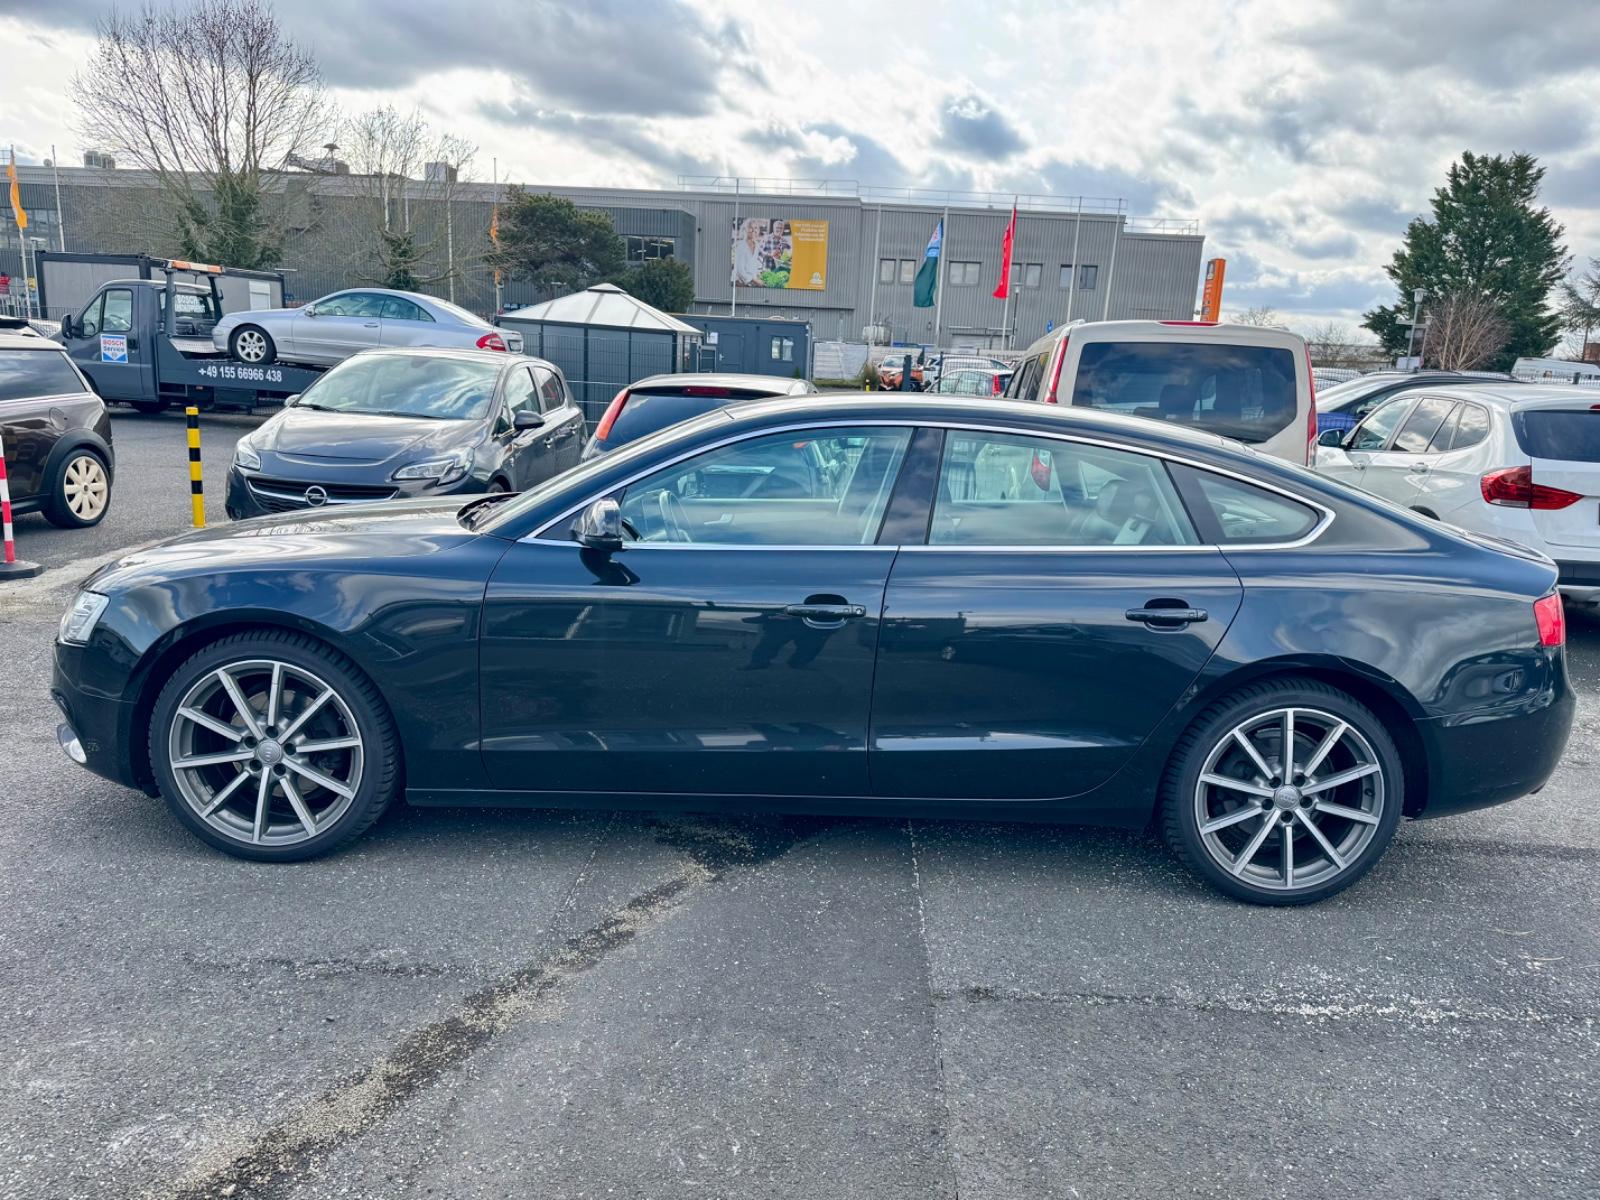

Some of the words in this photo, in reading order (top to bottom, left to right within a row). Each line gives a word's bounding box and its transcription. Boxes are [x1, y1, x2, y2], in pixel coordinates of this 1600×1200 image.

[198, 365, 218, 378] +49
[220, 366, 236, 379] 155
[237, 367, 264, 381] 66966
[266, 369, 282, 382] 438
